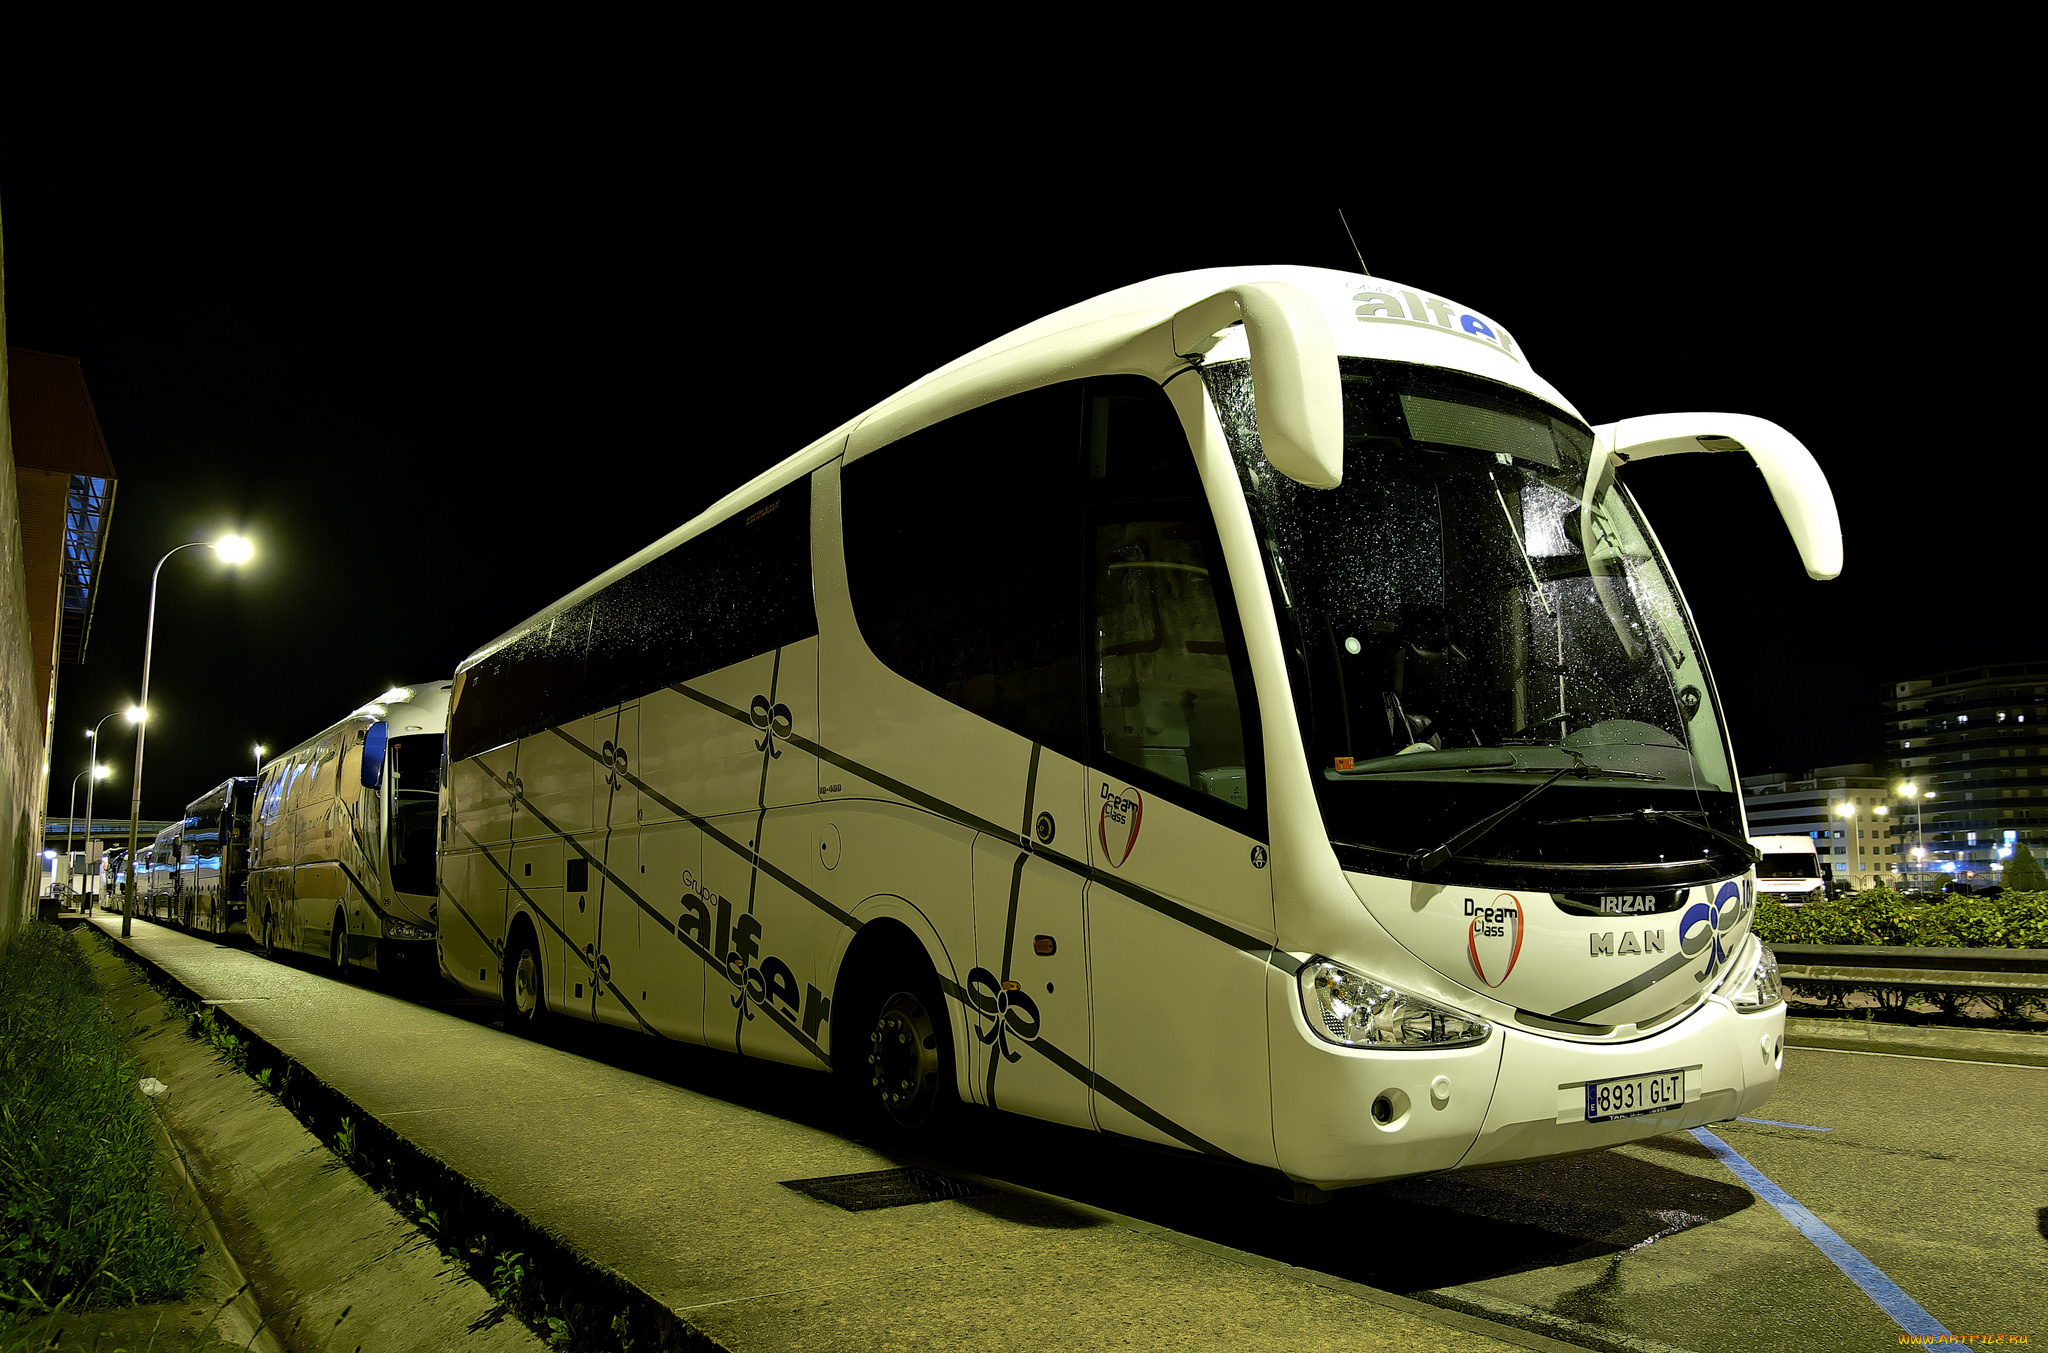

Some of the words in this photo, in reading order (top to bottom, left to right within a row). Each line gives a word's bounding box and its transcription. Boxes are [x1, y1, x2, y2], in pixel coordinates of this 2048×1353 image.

[1353, 290, 1513, 353] alfer
[1100, 782, 1139, 813] Dream
[682, 869, 718, 907] Grupo
[1464, 898, 1518, 923] Dream
[1600, 895, 1656, 913] IRIZAR
[1474, 919, 1505, 937] Class
[1589, 929, 1665, 957] MAN
[677, 894, 831, 1043] alfer
[1590, 1103, 1596, 1112] E
[1600, 1082, 1643, 1112] 8931
[1650, 1076, 1680, 1104] GLT
